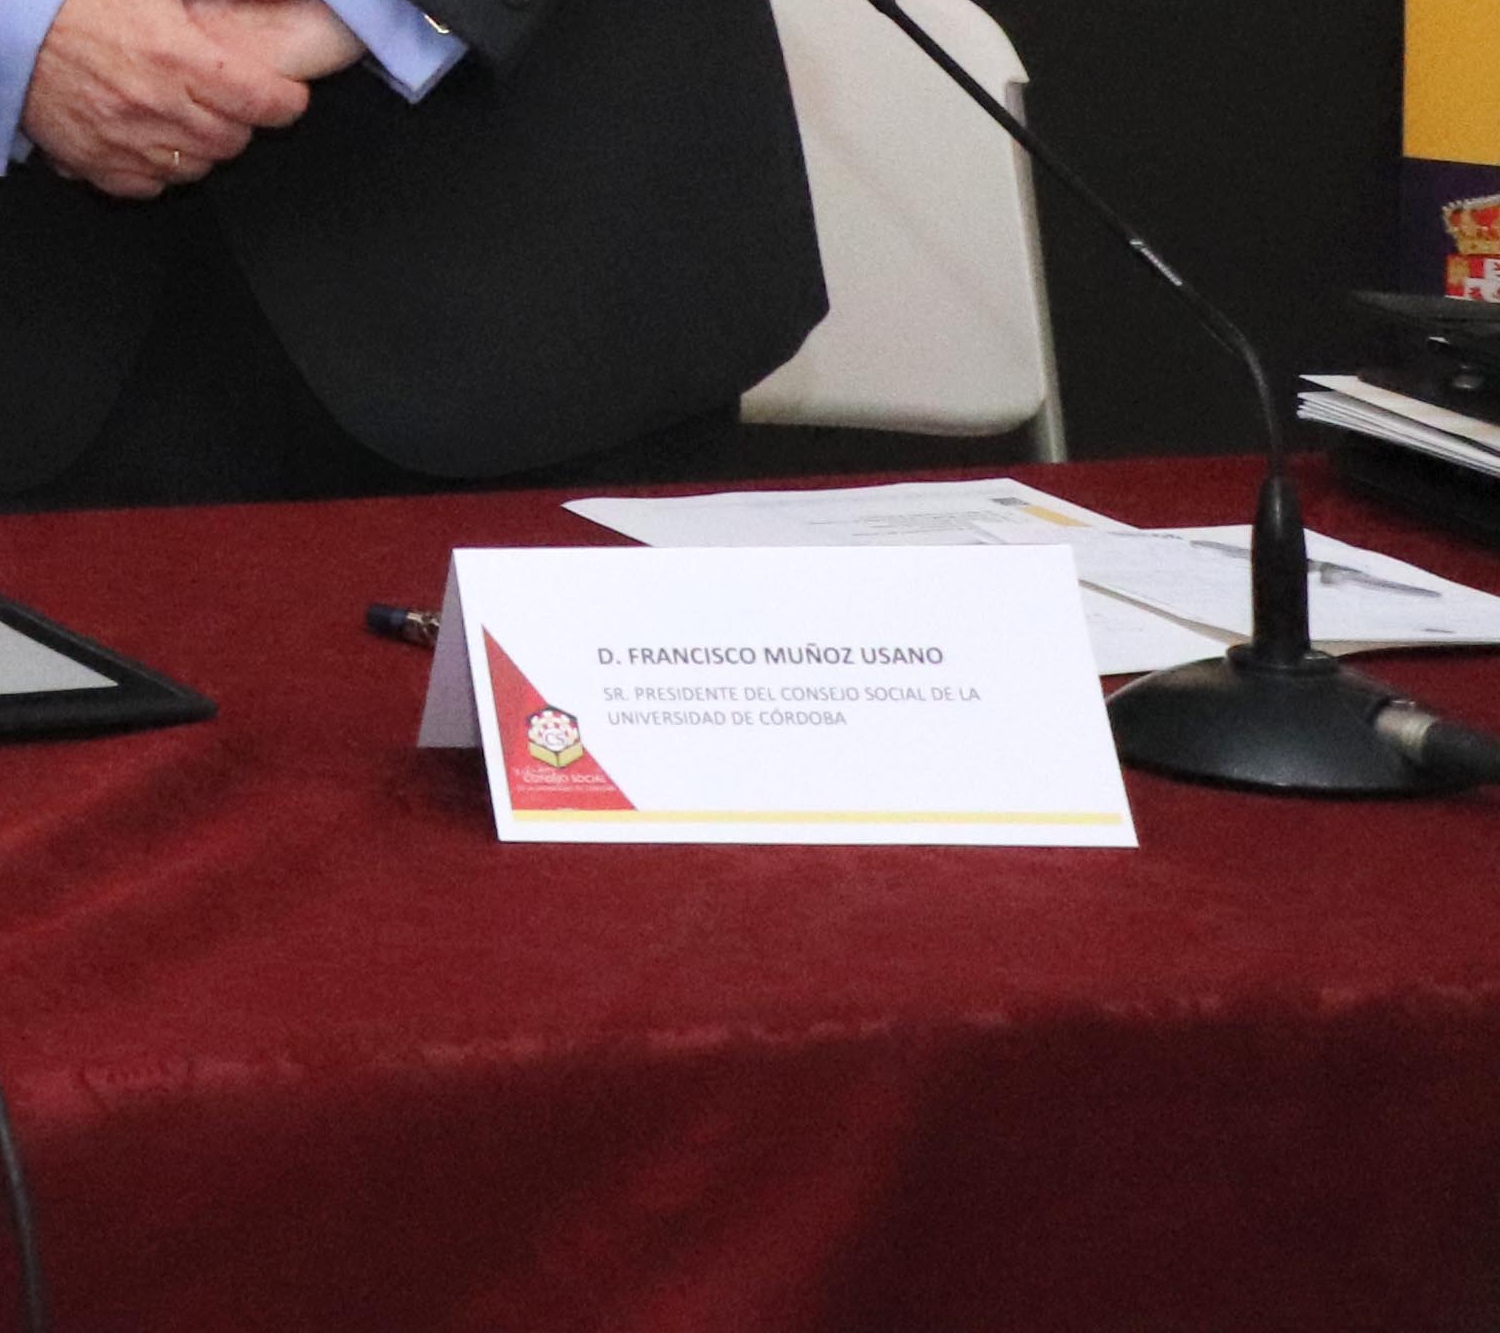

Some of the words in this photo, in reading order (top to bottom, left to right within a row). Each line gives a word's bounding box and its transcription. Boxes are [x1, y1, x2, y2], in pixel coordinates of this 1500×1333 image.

[597, 647, 621, 665] D.
[629, 647, 757, 665] FRANCISCO
[764, 643, 855, 665] MUÑOZ
[861, 647, 944, 665] USANO
[603, 686, 629, 702] SR.
[635, 686, 740, 703] PRESIDENTE
[744, 686, 777, 702] DEL
[780, 686, 860, 703] CONSEJO
[864, 686, 927, 702] SOCIAL
[931, 686, 954, 702] DE
[959, 686, 981, 702] LA
[607, 710, 727, 727] UNIVERSIDAD
[732, 710, 754, 726] DE
[759, 707, 848, 727] CÓRDOBA
